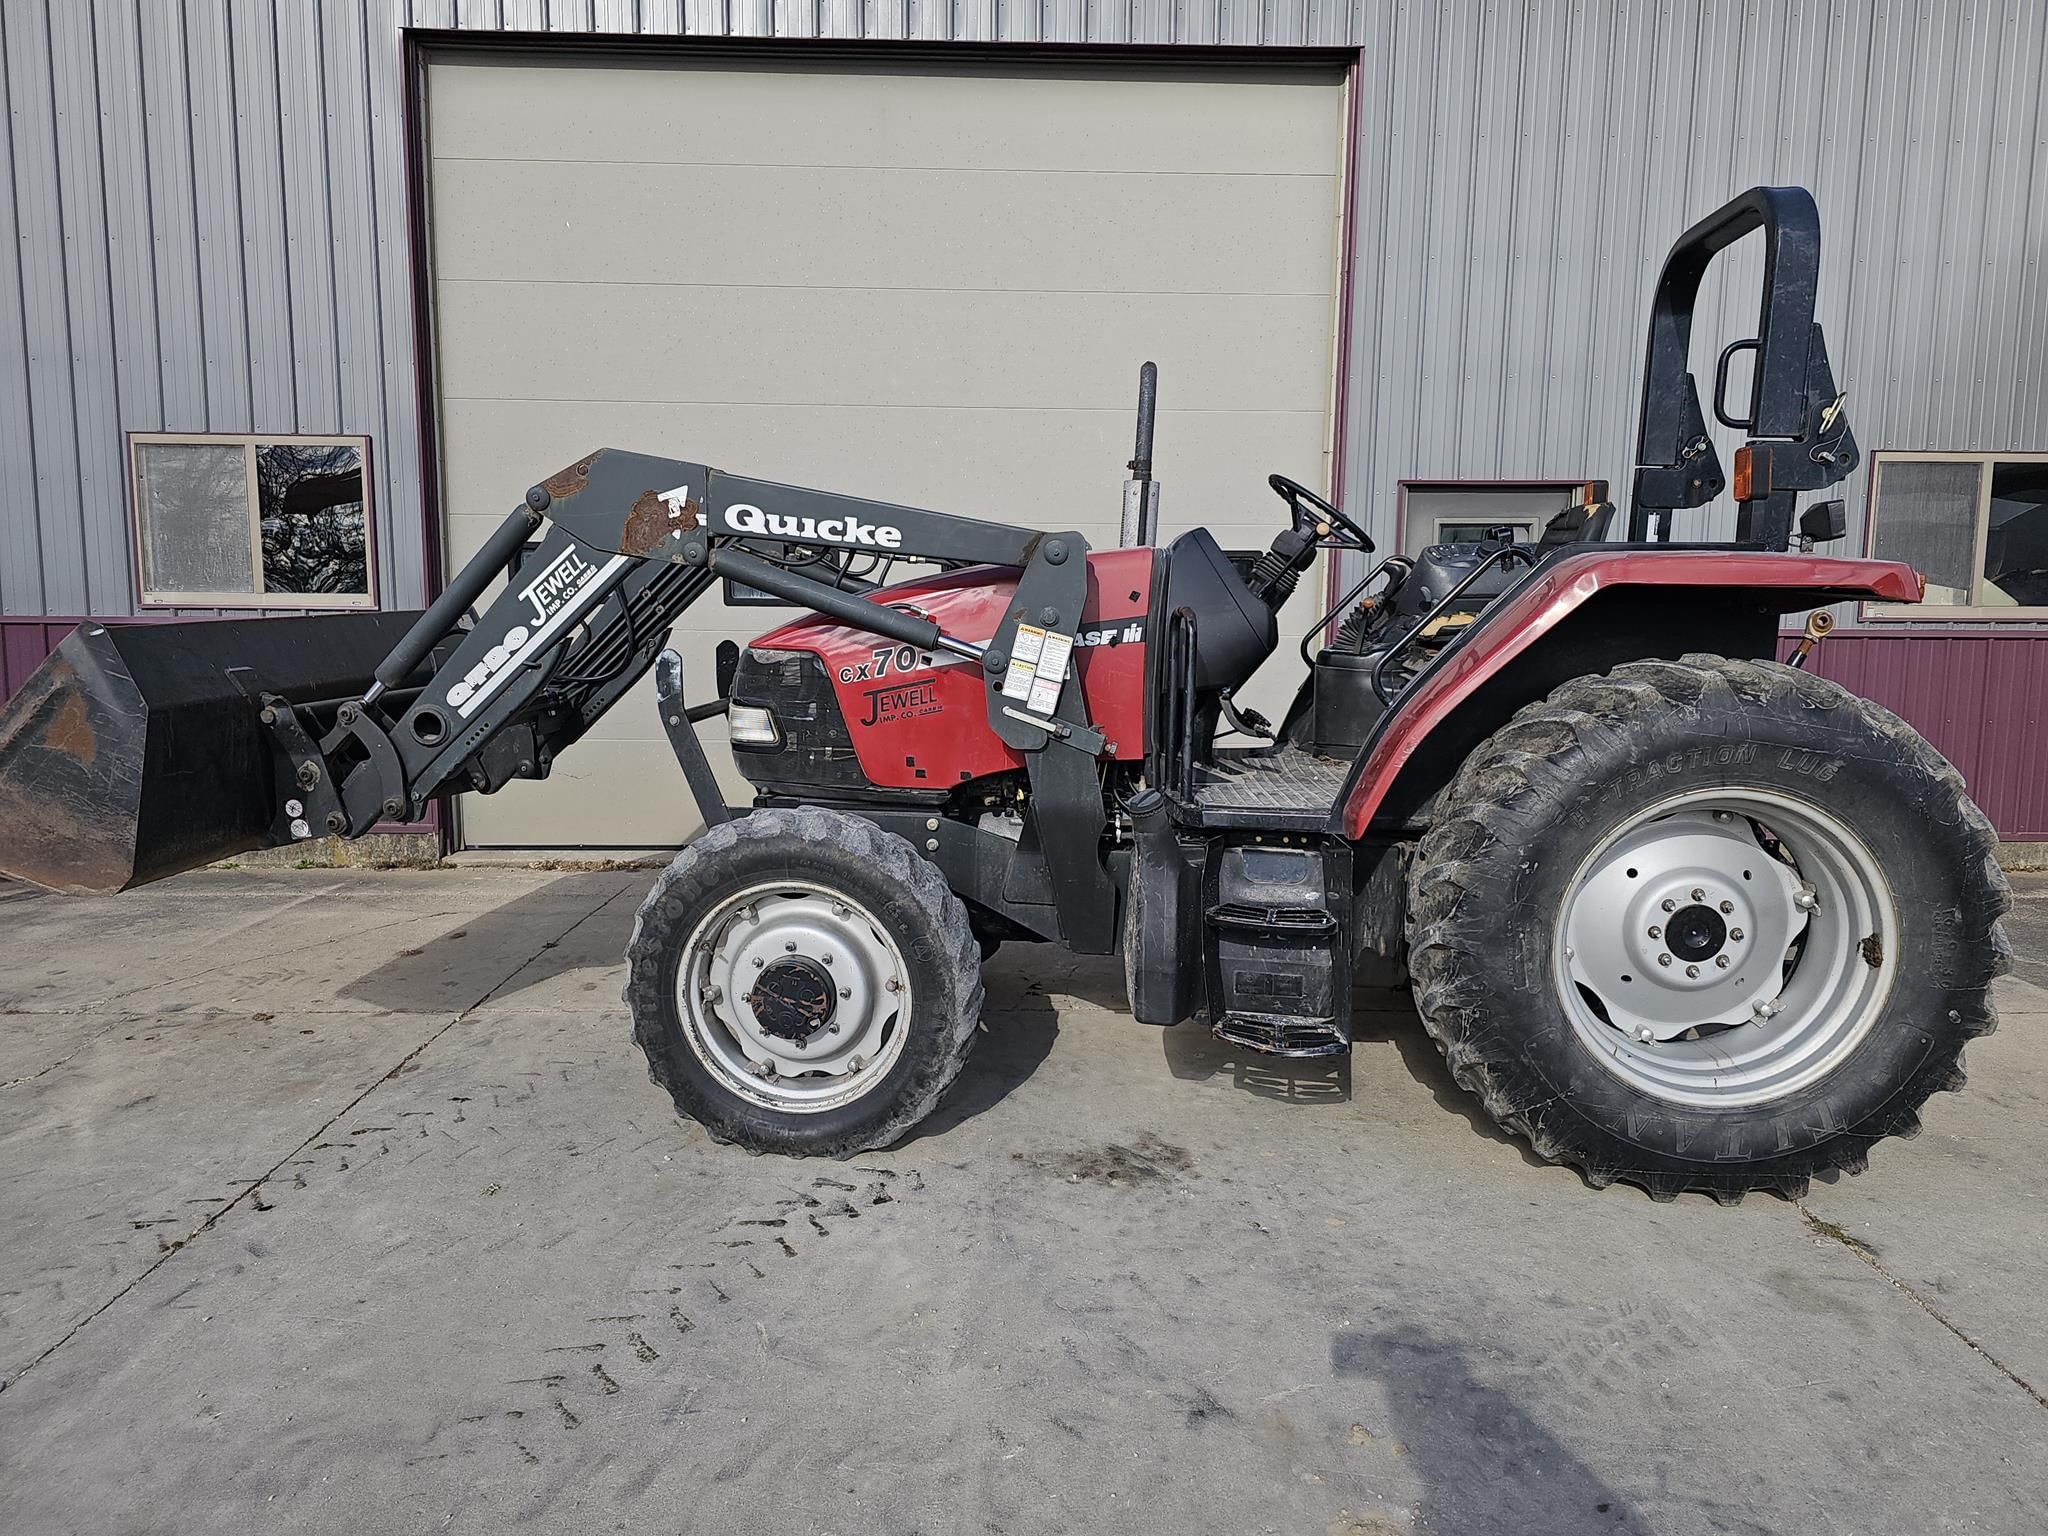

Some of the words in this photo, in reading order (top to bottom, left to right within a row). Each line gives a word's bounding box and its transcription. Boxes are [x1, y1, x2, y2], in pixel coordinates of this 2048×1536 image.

[724, 503, 902, 548] Quicke
[517, 543, 588, 627] JEWELL
[1073, 629, 1117, 647] ASE
[860, 677, 937, 727] JEWELL
[1776, 749, 1842, 782] LUG
[1606, 1098, 1848, 1161] TITAN
